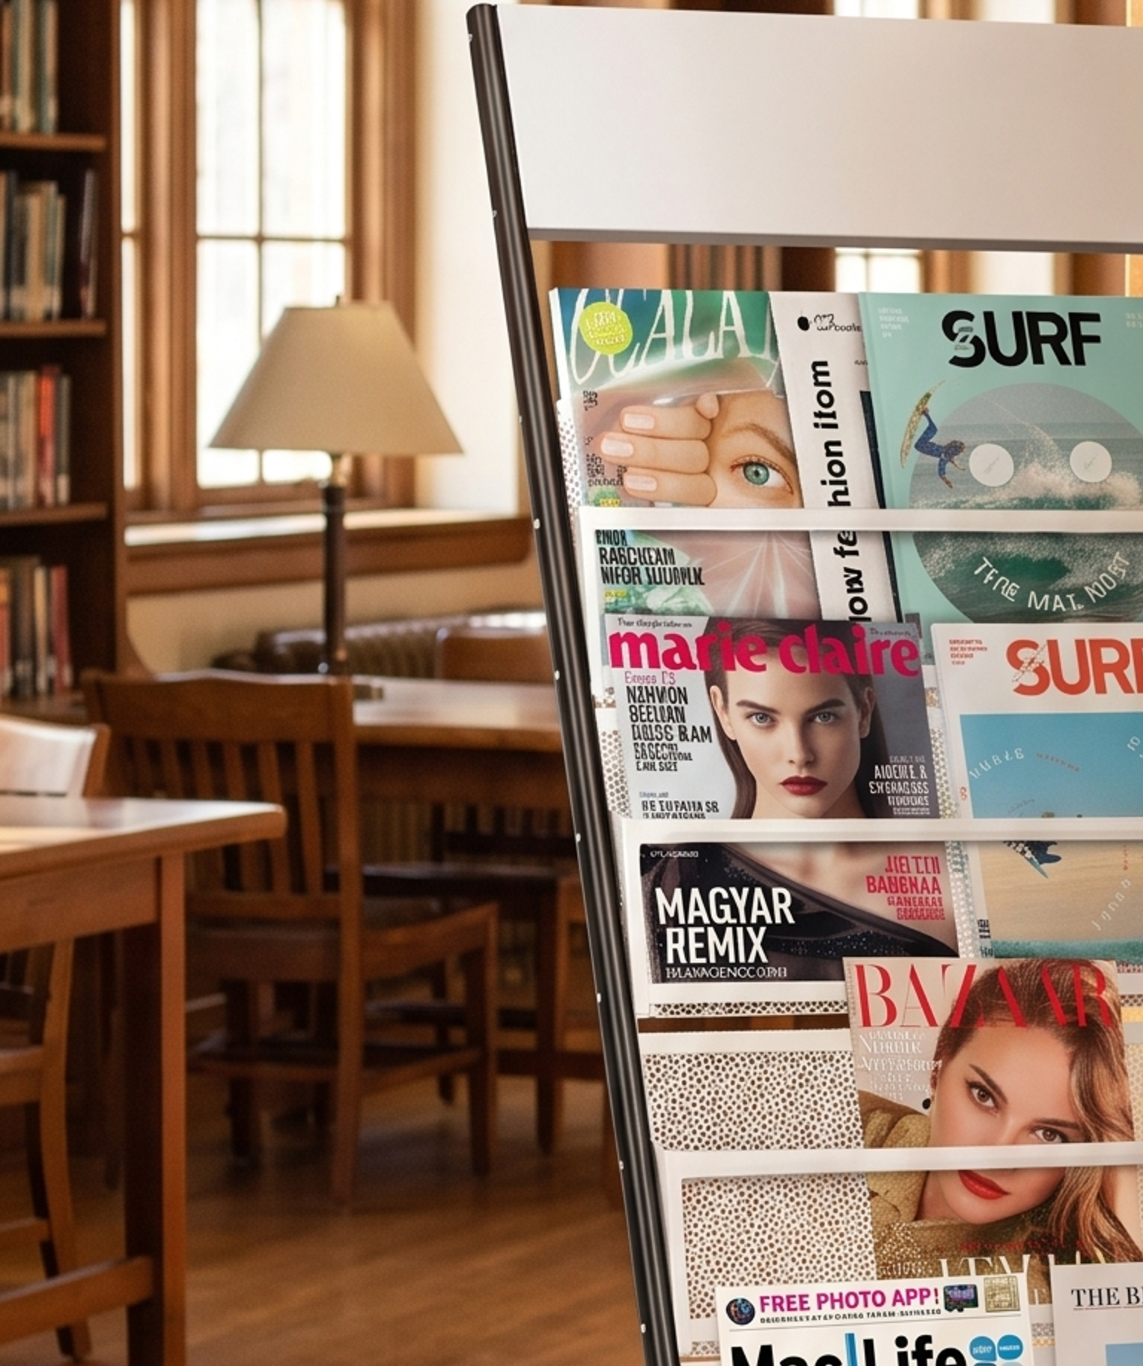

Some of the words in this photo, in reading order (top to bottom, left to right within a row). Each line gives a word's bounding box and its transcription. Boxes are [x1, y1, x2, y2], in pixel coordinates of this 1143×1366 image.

[942, 310, 1101, 368] SURF
[609, 622, 768, 673] marie
[778, 623, 920, 677] claire
[655, 886, 796, 925] MAGYAR
[666, 926, 768, 964] REMIX
[854, 964, 1113, 1027] BAZAAR
[759, 1294, 811, 1313] FREE
[816, 1290, 886, 1311] PHOTO
[1071, 1287, 1120, 1307] THE
